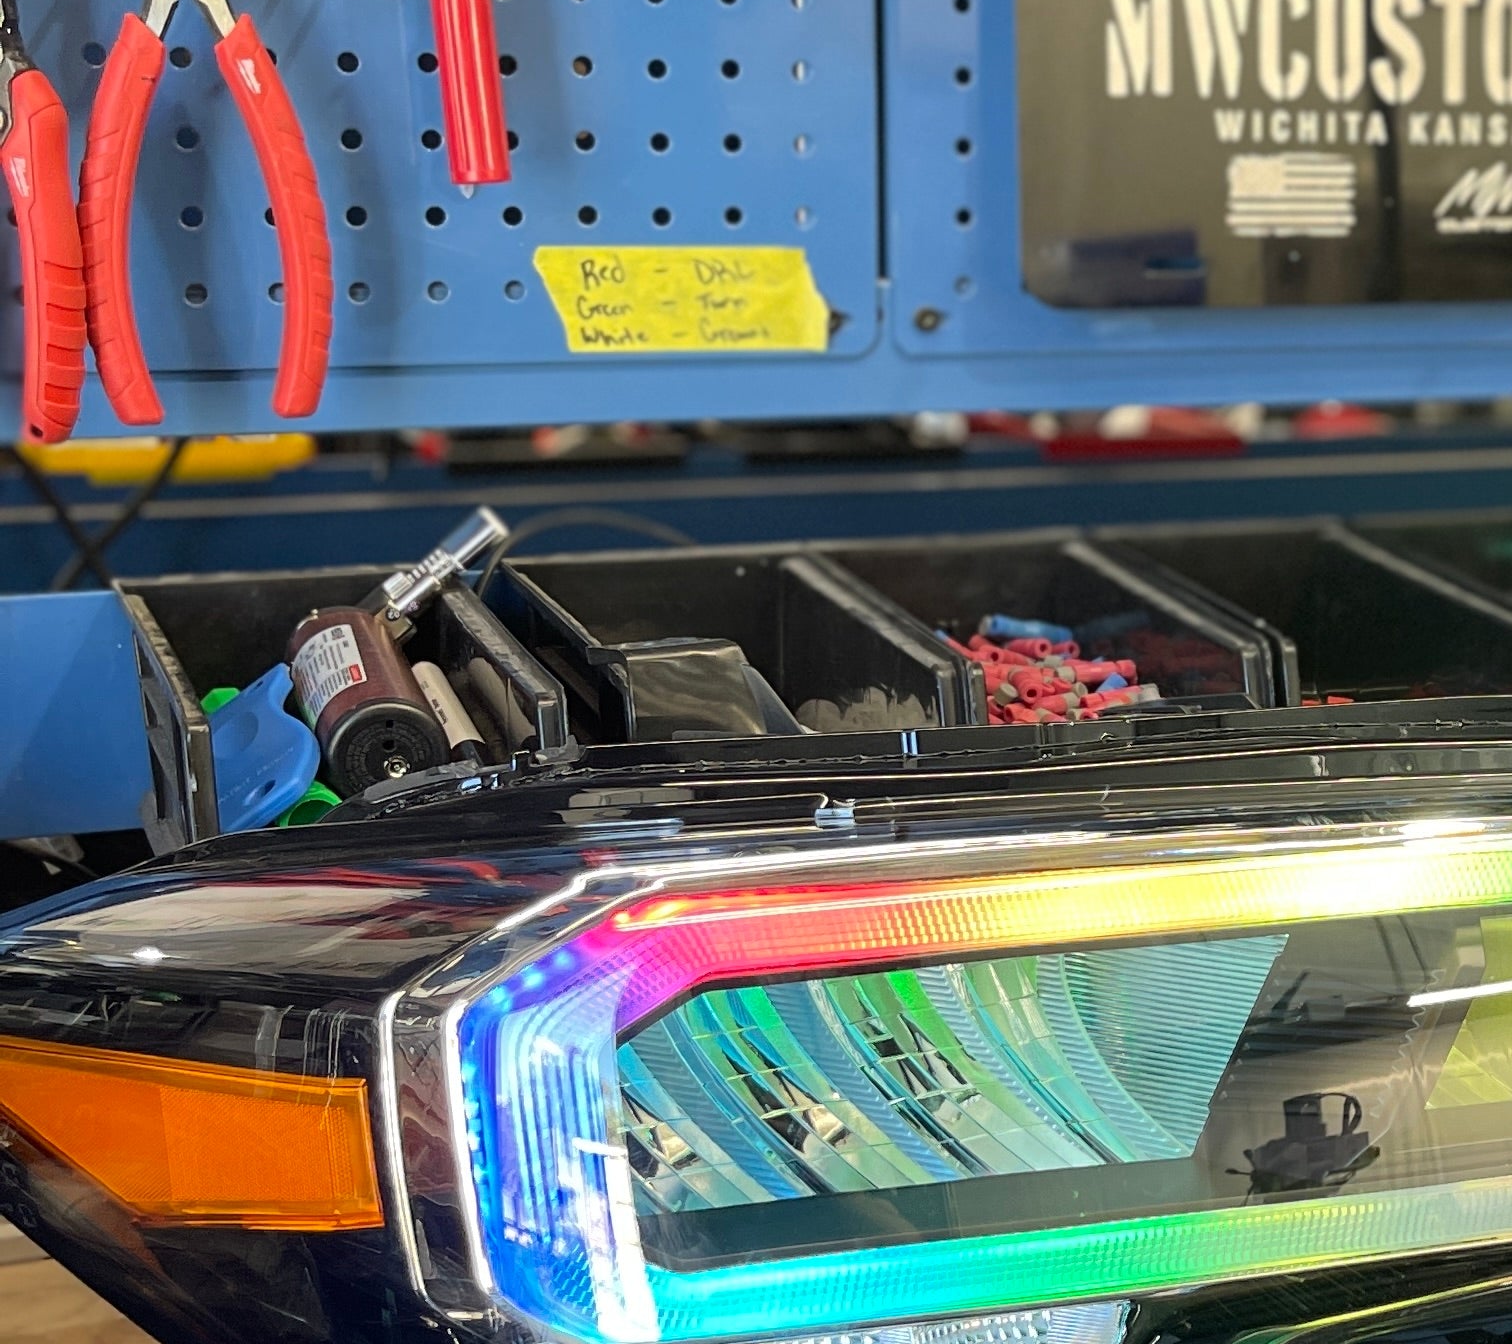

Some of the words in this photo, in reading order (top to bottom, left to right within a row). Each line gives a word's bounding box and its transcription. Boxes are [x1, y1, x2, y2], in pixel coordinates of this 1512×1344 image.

[1213, 108, 1390, 146] WICHITA
[580, 254, 626, 291] Red
[576, 294, 633, 320] Green
[580, 326, 650, 346] White
